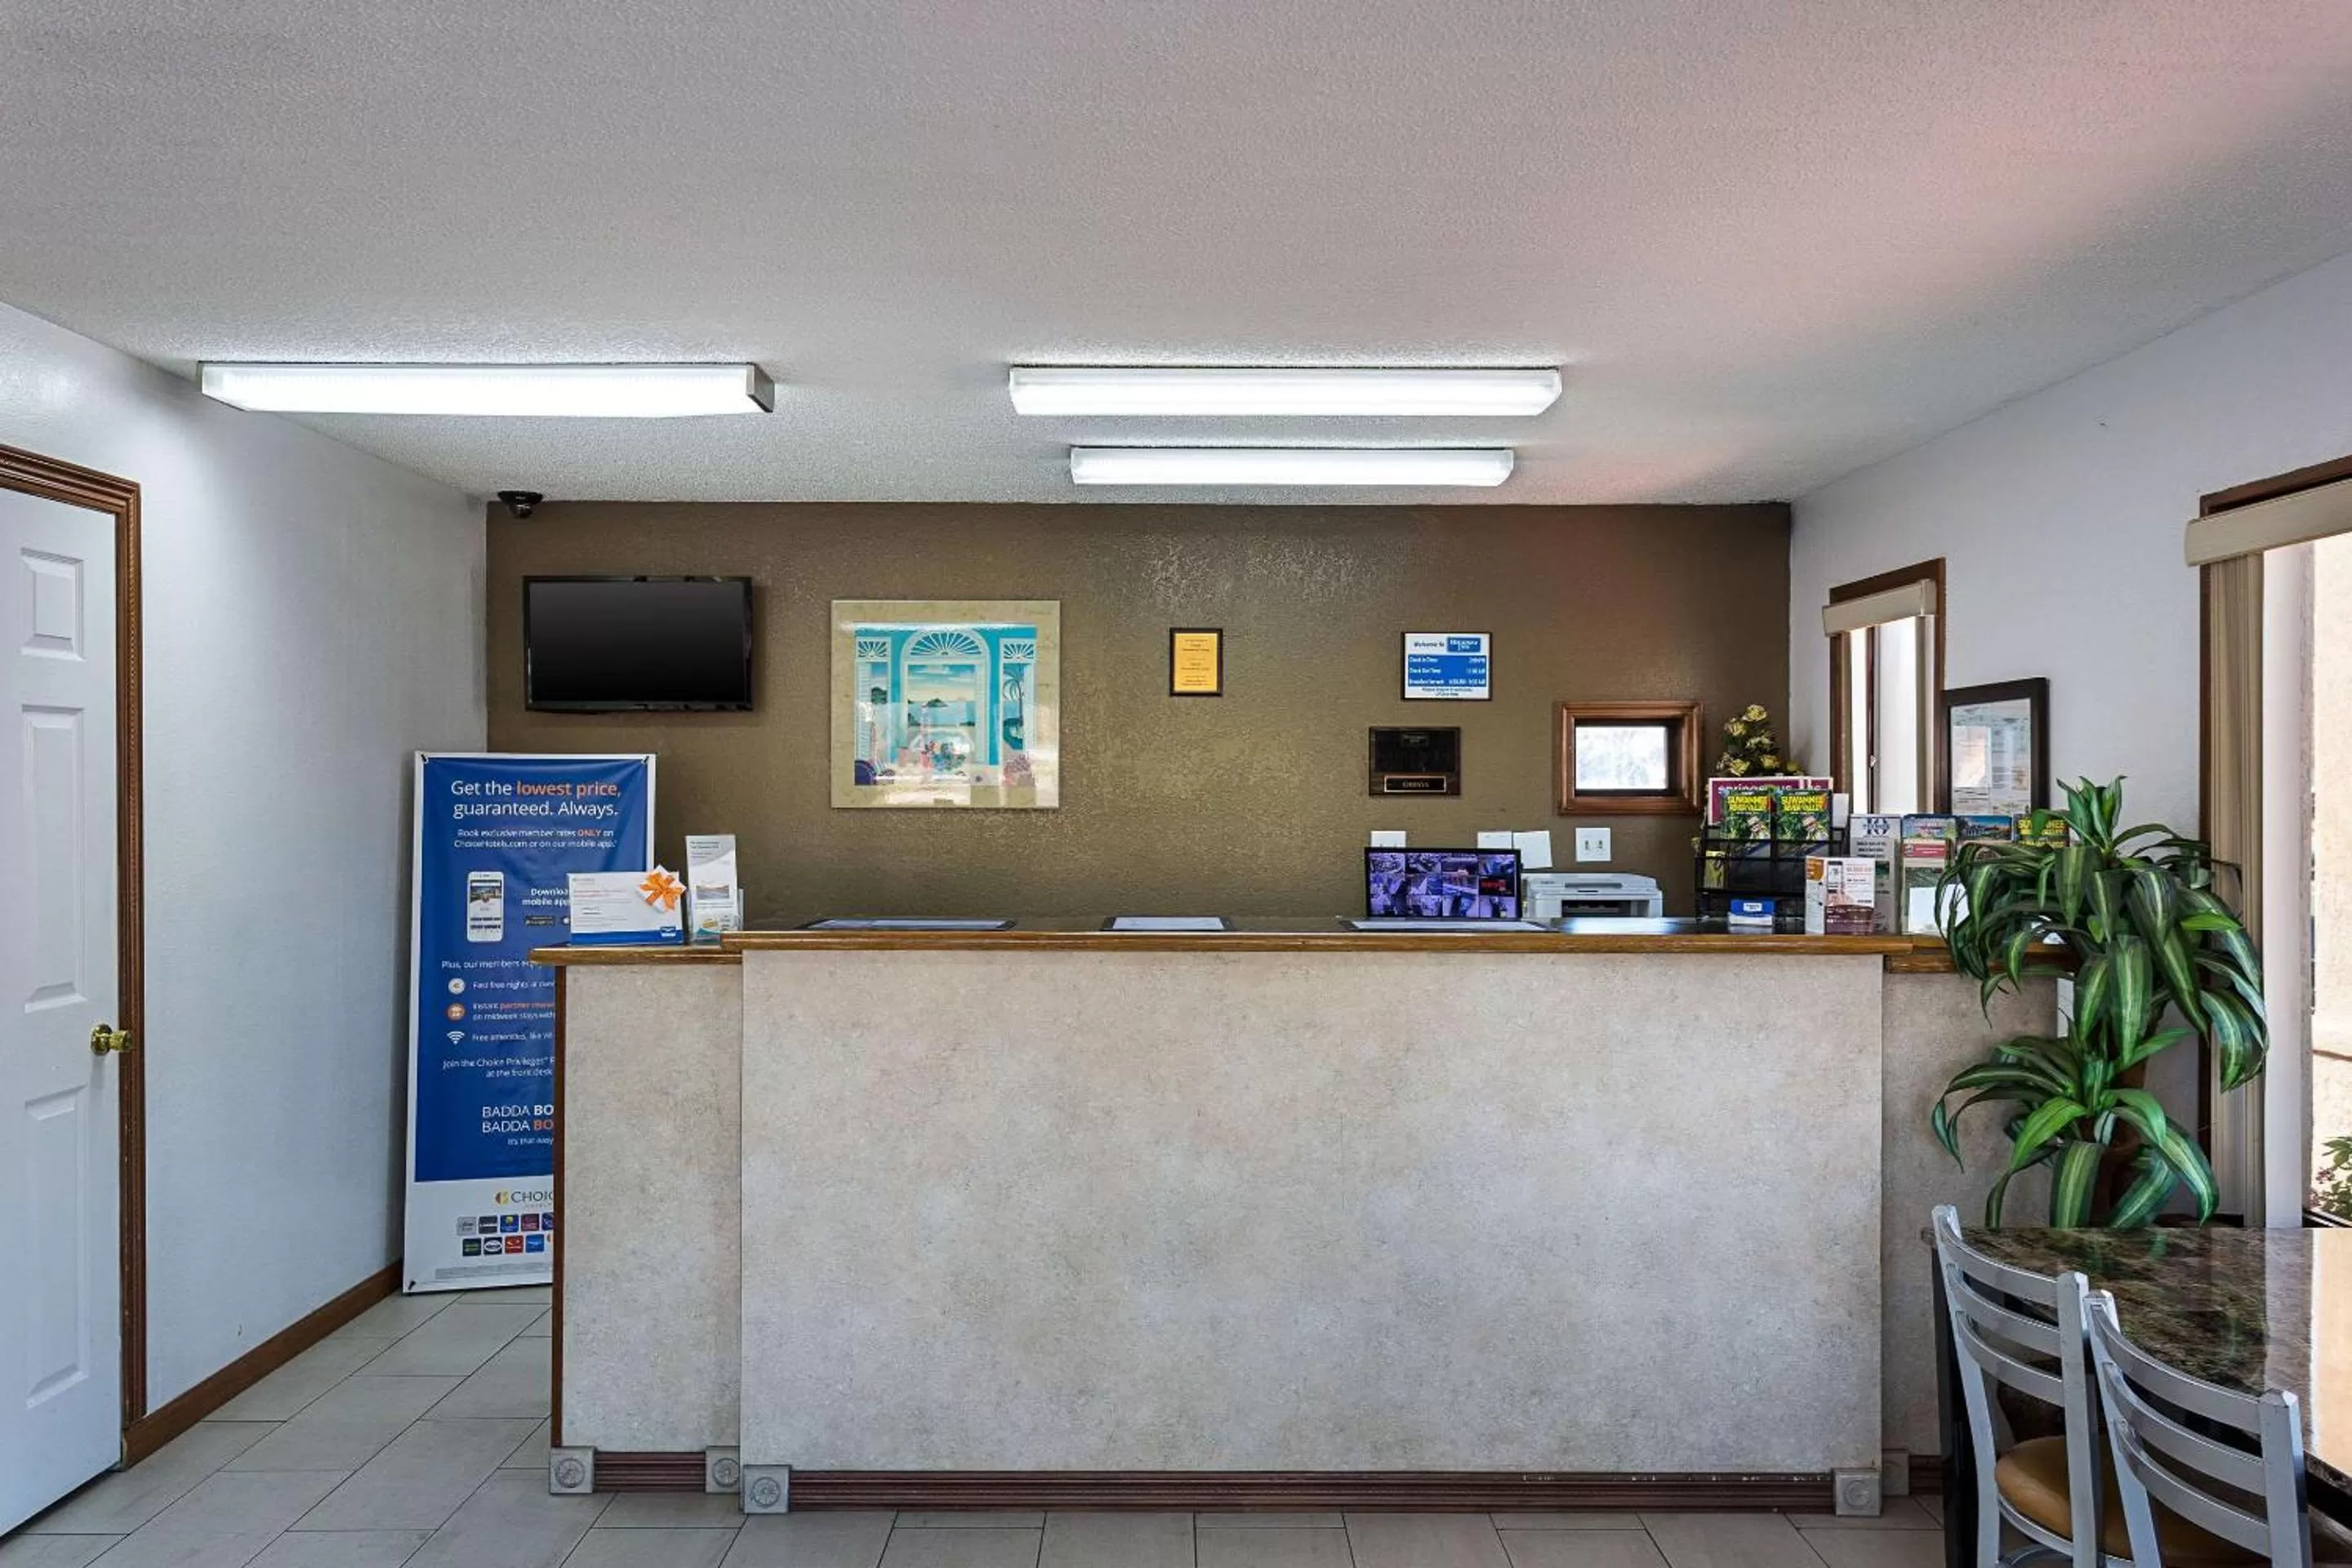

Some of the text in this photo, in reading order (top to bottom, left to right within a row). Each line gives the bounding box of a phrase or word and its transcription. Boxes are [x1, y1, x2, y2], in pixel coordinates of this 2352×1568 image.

[451, 780, 621, 800] Get the lowest price,
[452, 801, 619, 820] guaranteed. Always.
[457, 829, 479, 837] Book
[480, 828, 518, 837] exclusive
[519, 828, 555, 837] member
[577, 829, 602, 837] ONLY
[454, 840, 528, 848] ChoiceHotels.com
[567, 840, 596, 848] mobile
[530, 888, 569, 896] Downloa
[522, 898, 553, 906] mobile
[441, 960, 461, 969] Plus,
[479, 960, 520, 969] members
[472, 1032, 489, 1041] Free
[443, 1059, 460, 1070] Join
[476, 1058, 505, 1067] Choice
[482, 1104, 555, 1118] BADDA BO
[482, 1120, 555, 1133] BADDA BO
[510, 1191, 553, 1204] CHOI
